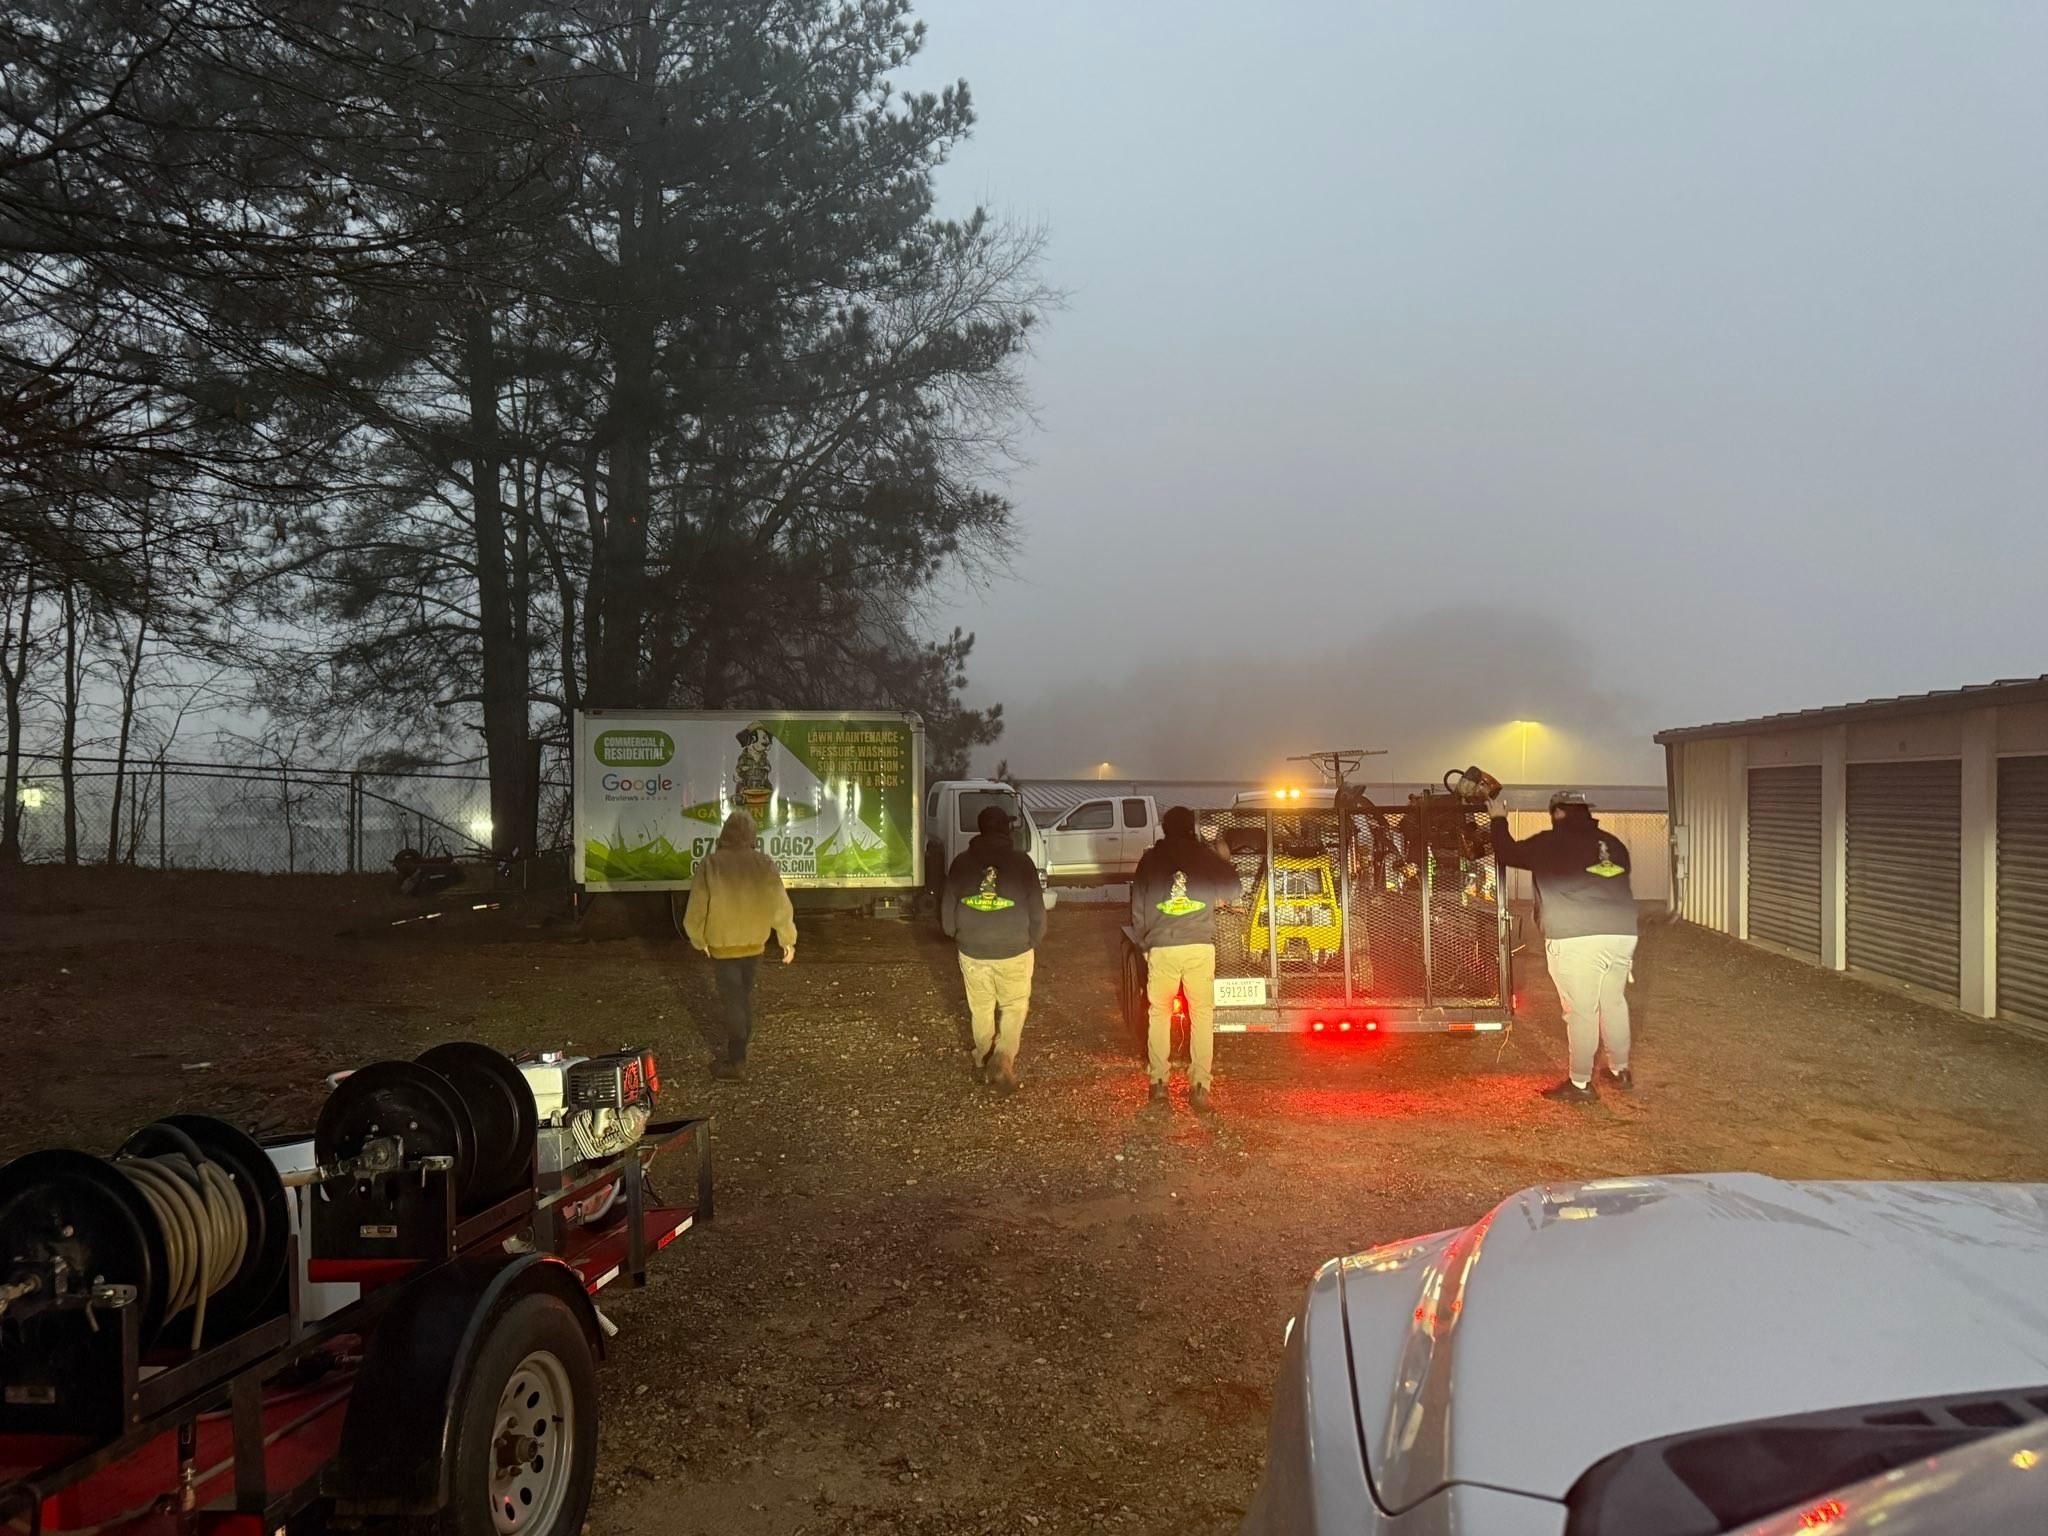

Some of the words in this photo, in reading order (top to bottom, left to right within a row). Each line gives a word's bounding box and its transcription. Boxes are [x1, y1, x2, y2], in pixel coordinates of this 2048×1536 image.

[604, 736, 657, 747] COMMERCIAL
[807, 731, 833, 743] LAWN
[836, 731, 898, 743] MAINTENANCE
[604, 748, 665, 760] RESIDENTIAL
[809, 745, 857, 757] PRESSURE
[858, 745, 899, 757] WASHING
[817, 760, 836, 772] SOD
[839, 760, 899, 772] INSTALLATION
[602, 773, 673, 796] Google
[875, 775, 898, 787] ROCK
[697, 807, 718, 818] GA
[692, 837, 720, 858] 67
[770, 836, 814, 856] 0462
